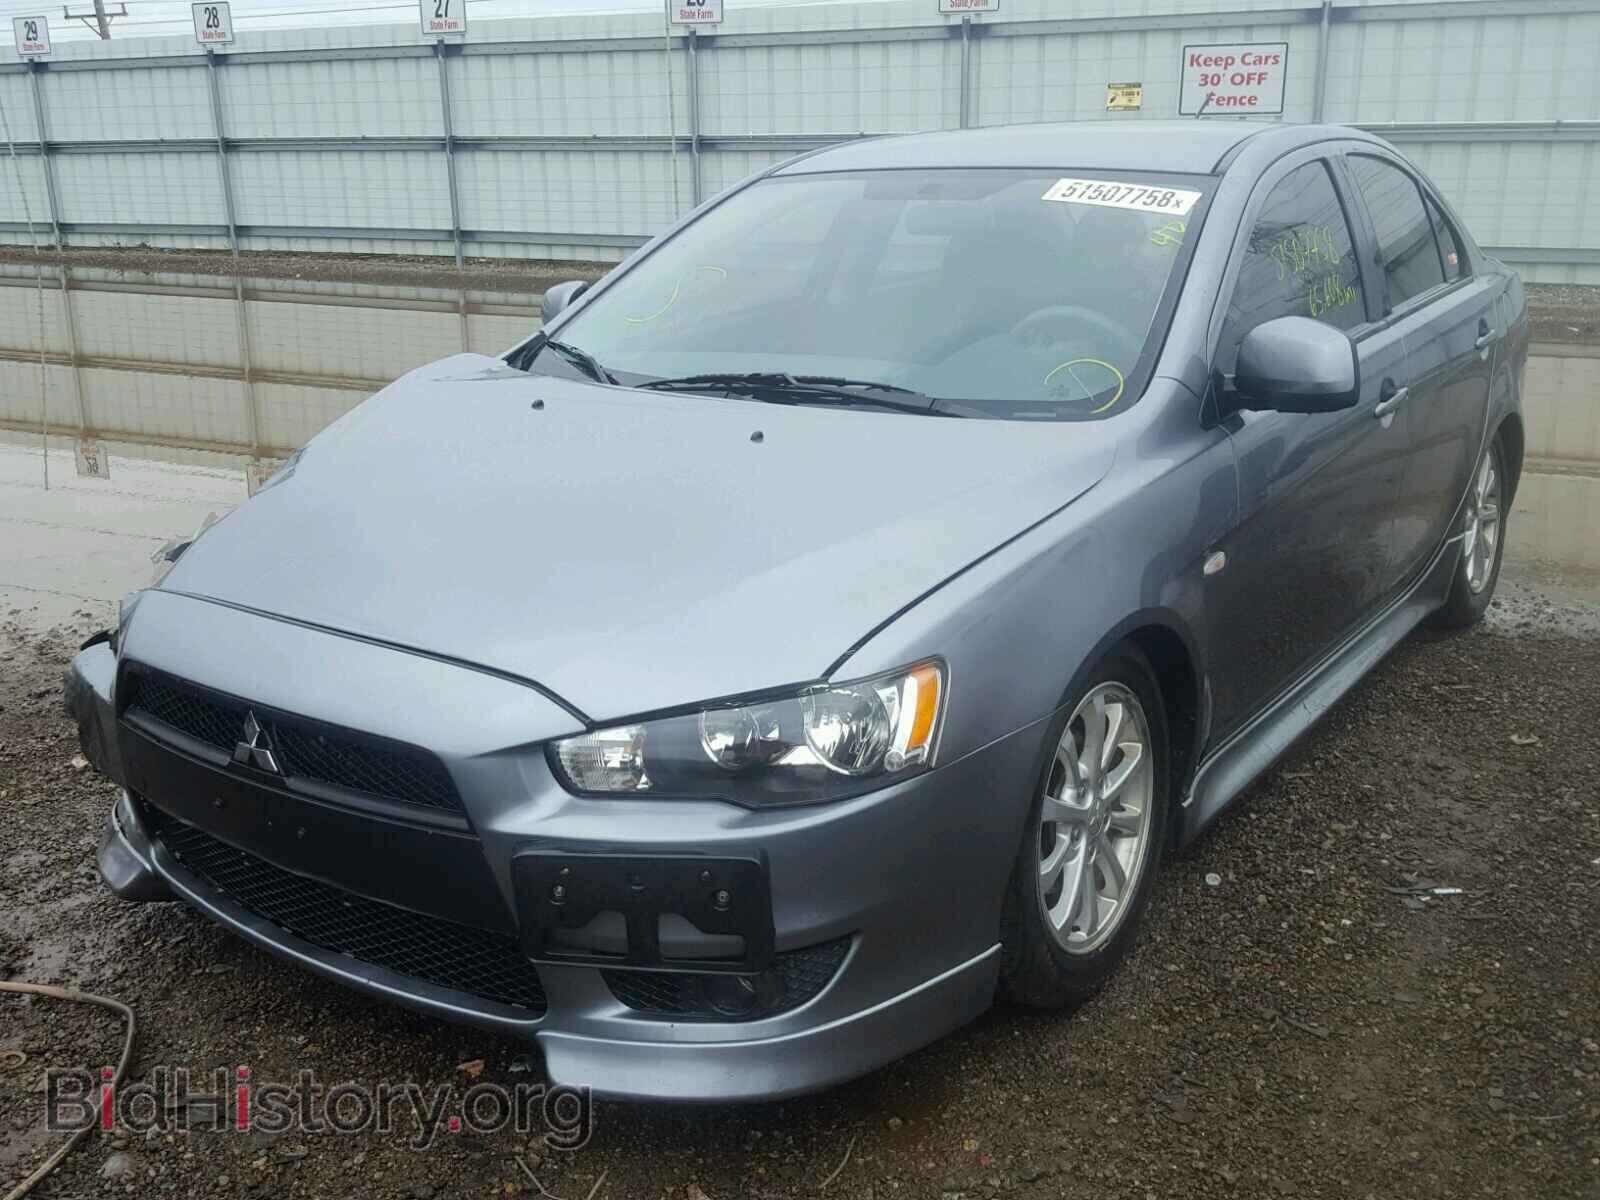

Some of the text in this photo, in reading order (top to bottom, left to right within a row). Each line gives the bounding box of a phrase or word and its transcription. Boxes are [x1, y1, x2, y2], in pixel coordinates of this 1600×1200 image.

[204, 7, 220, 28] 28
[433, 0, 449, 18] 27
[680, 9, 713, 19] State Farm
[24, 21, 38, 41] 29
[1189, 52, 1280, 70] Keep Cars
[1198, 72, 1269, 87] 30' OFF
[1207, 93, 1258, 107] Fence
